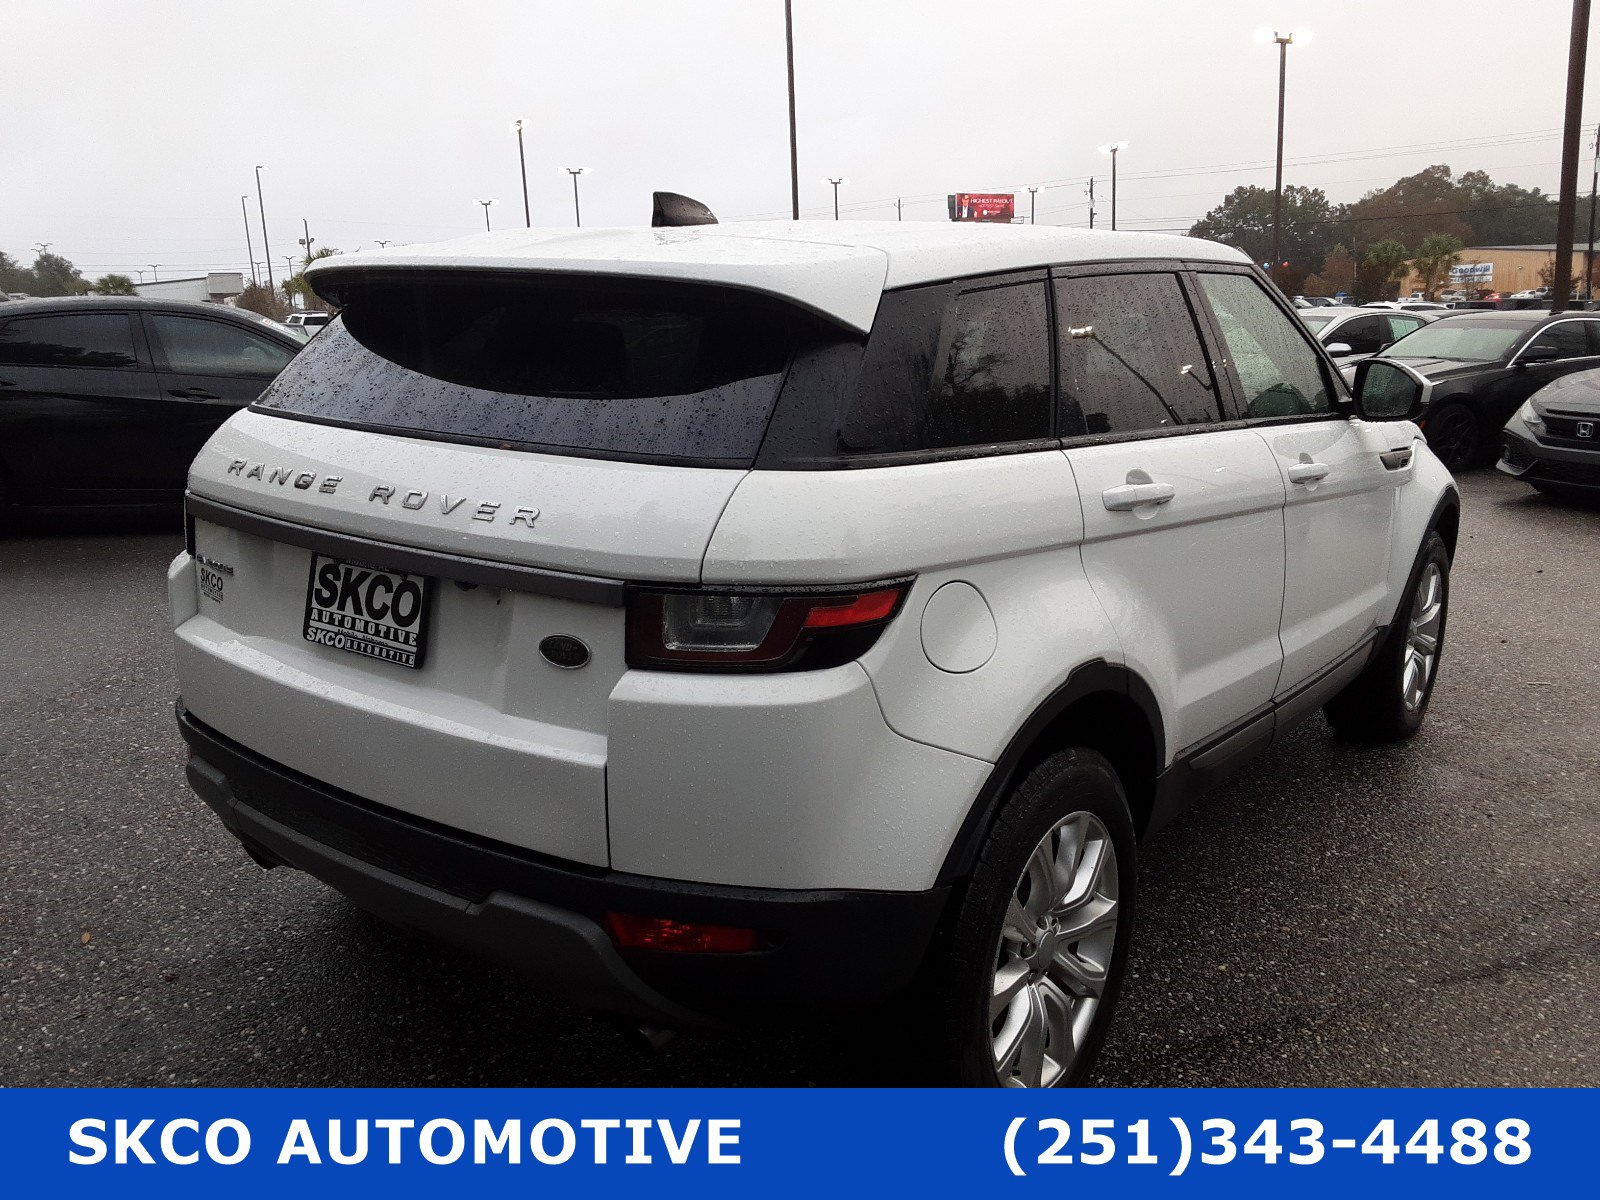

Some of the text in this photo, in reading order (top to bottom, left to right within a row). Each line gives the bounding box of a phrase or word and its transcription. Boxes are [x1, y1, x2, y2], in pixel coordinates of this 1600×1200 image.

[1451, 265, 1491, 275] Goodwill
[227, 458, 541, 529] RANGE ROVER
[200, 567, 224, 591] SKCO
[314, 563, 422, 628] SKCO
[306, 627, 415, 665] SKCO AUTOMOTIVE
[310, 608, 417, 646] AUTOMOTIVE
